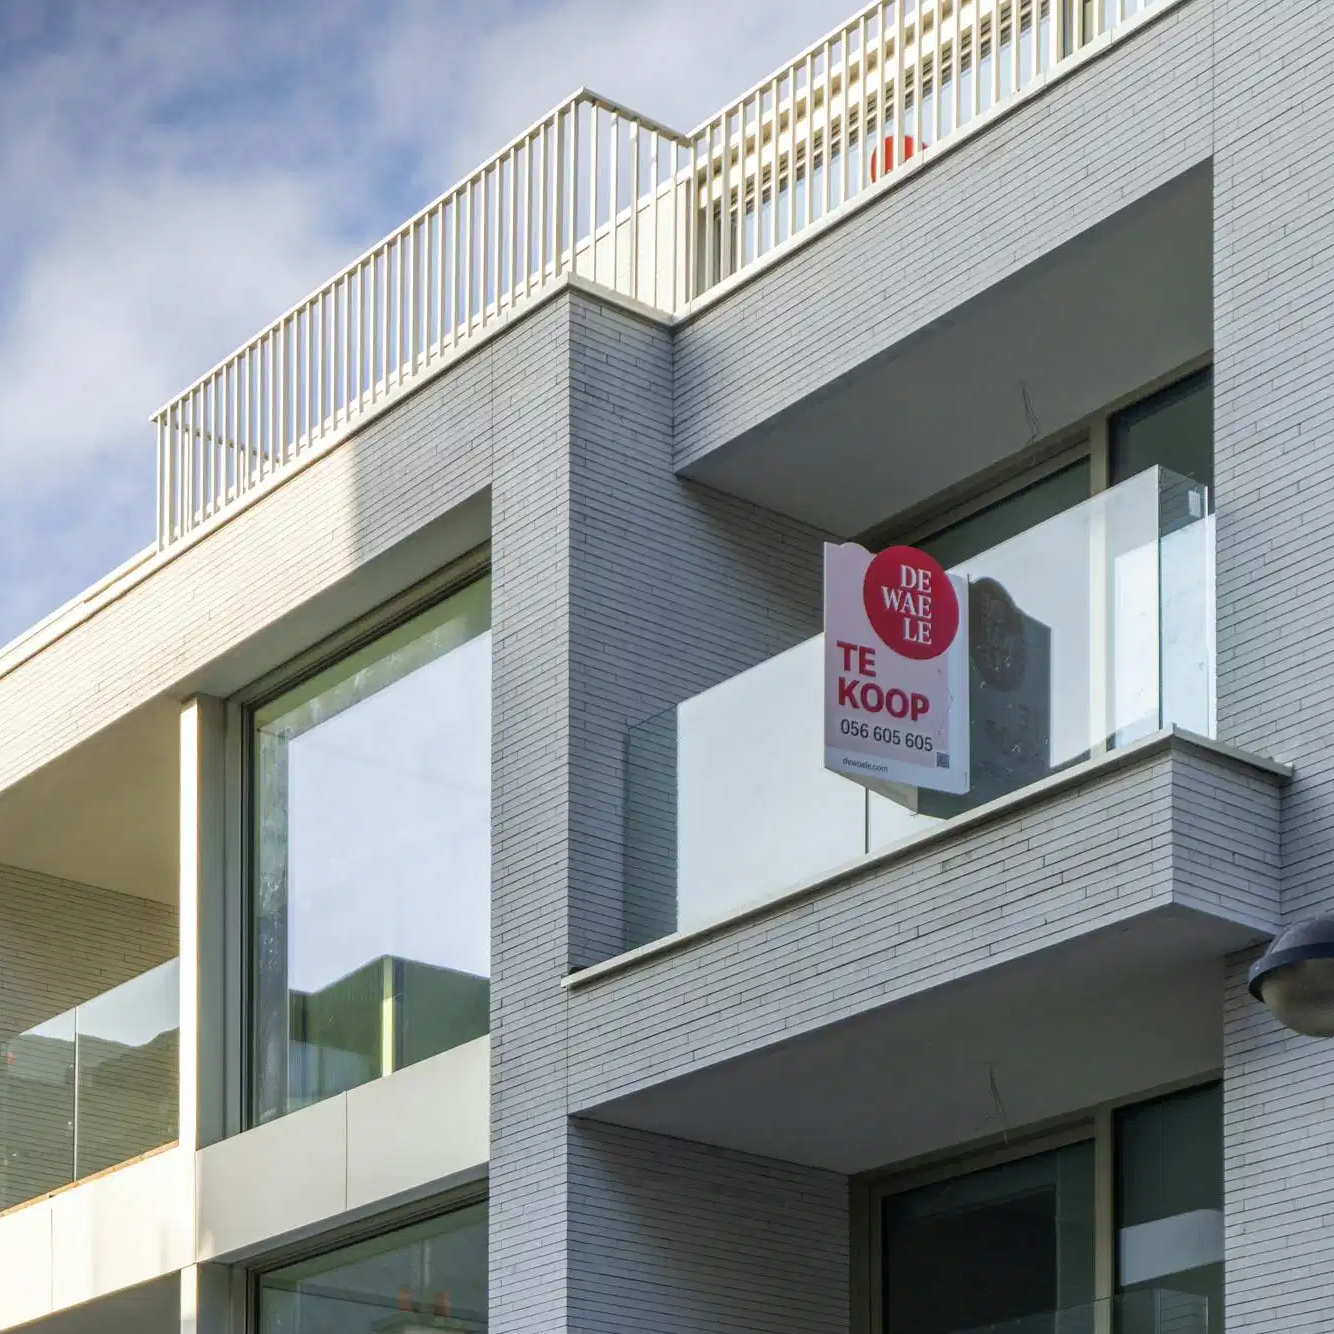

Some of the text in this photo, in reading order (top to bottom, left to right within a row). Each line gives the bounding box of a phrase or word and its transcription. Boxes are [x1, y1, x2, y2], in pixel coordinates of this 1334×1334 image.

[900, 564, 932, 593] DE
[881, 585, 932, 619] WAE
[903, 617, 932, 645] LE
[837, 640, 876, 677] TE
[838, 676, 930, 721] KOOP
[841, 719, 933, 752] 056 605 605
[842, 756, 888, 773] dewaele.com
